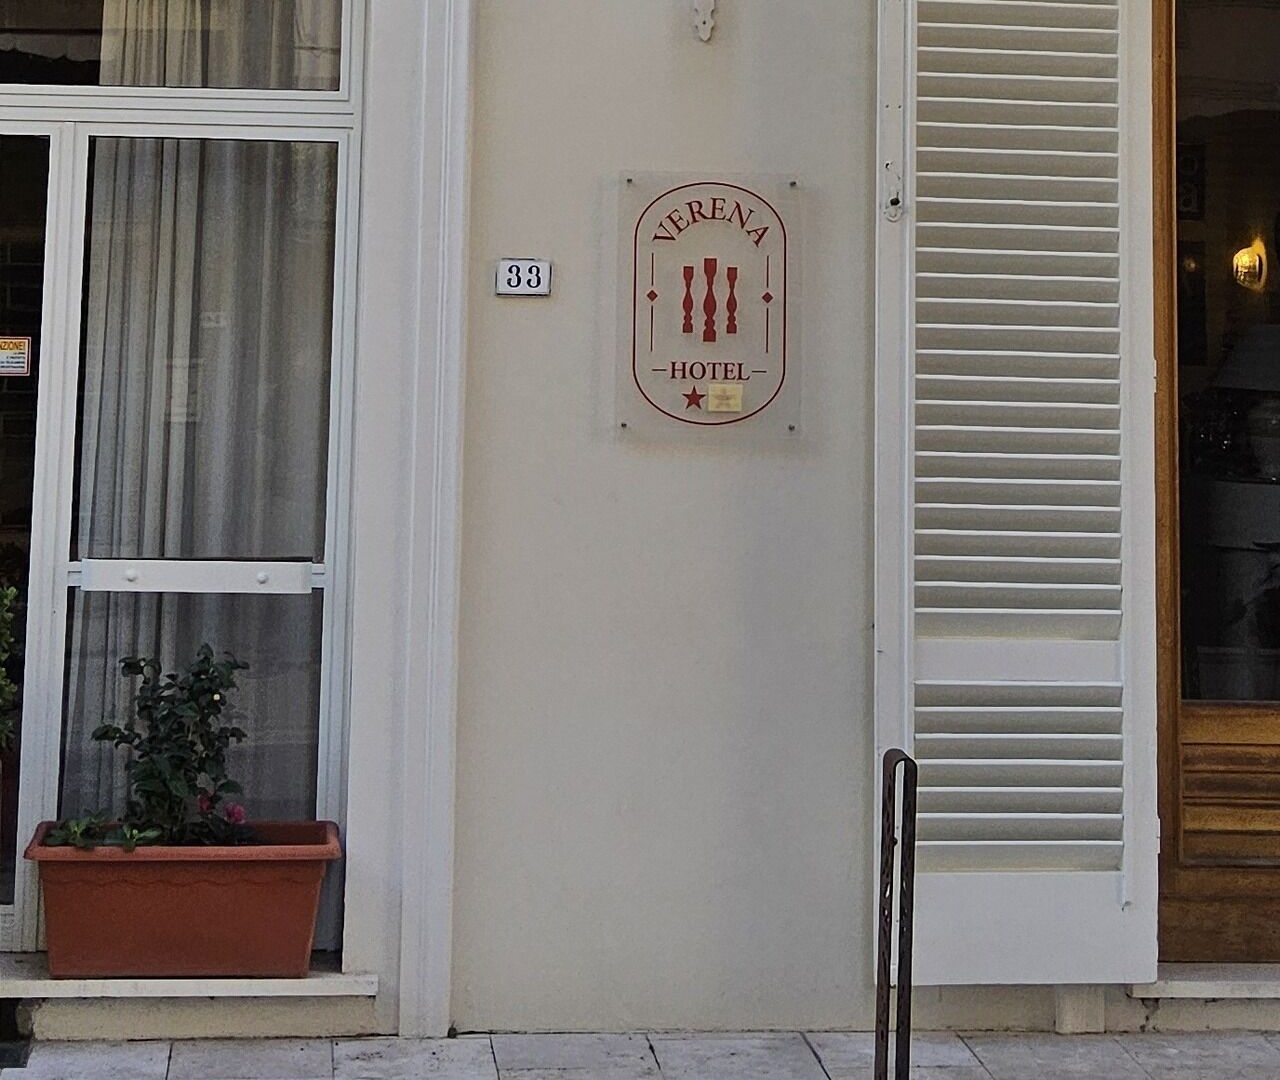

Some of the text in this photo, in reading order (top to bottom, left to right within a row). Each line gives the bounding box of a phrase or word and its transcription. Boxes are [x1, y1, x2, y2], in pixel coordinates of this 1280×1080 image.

[651, 196, 771, 248] VERENA
[506, 264, 543, 289] 33
[670, 361, 751, 381] HOTEL
